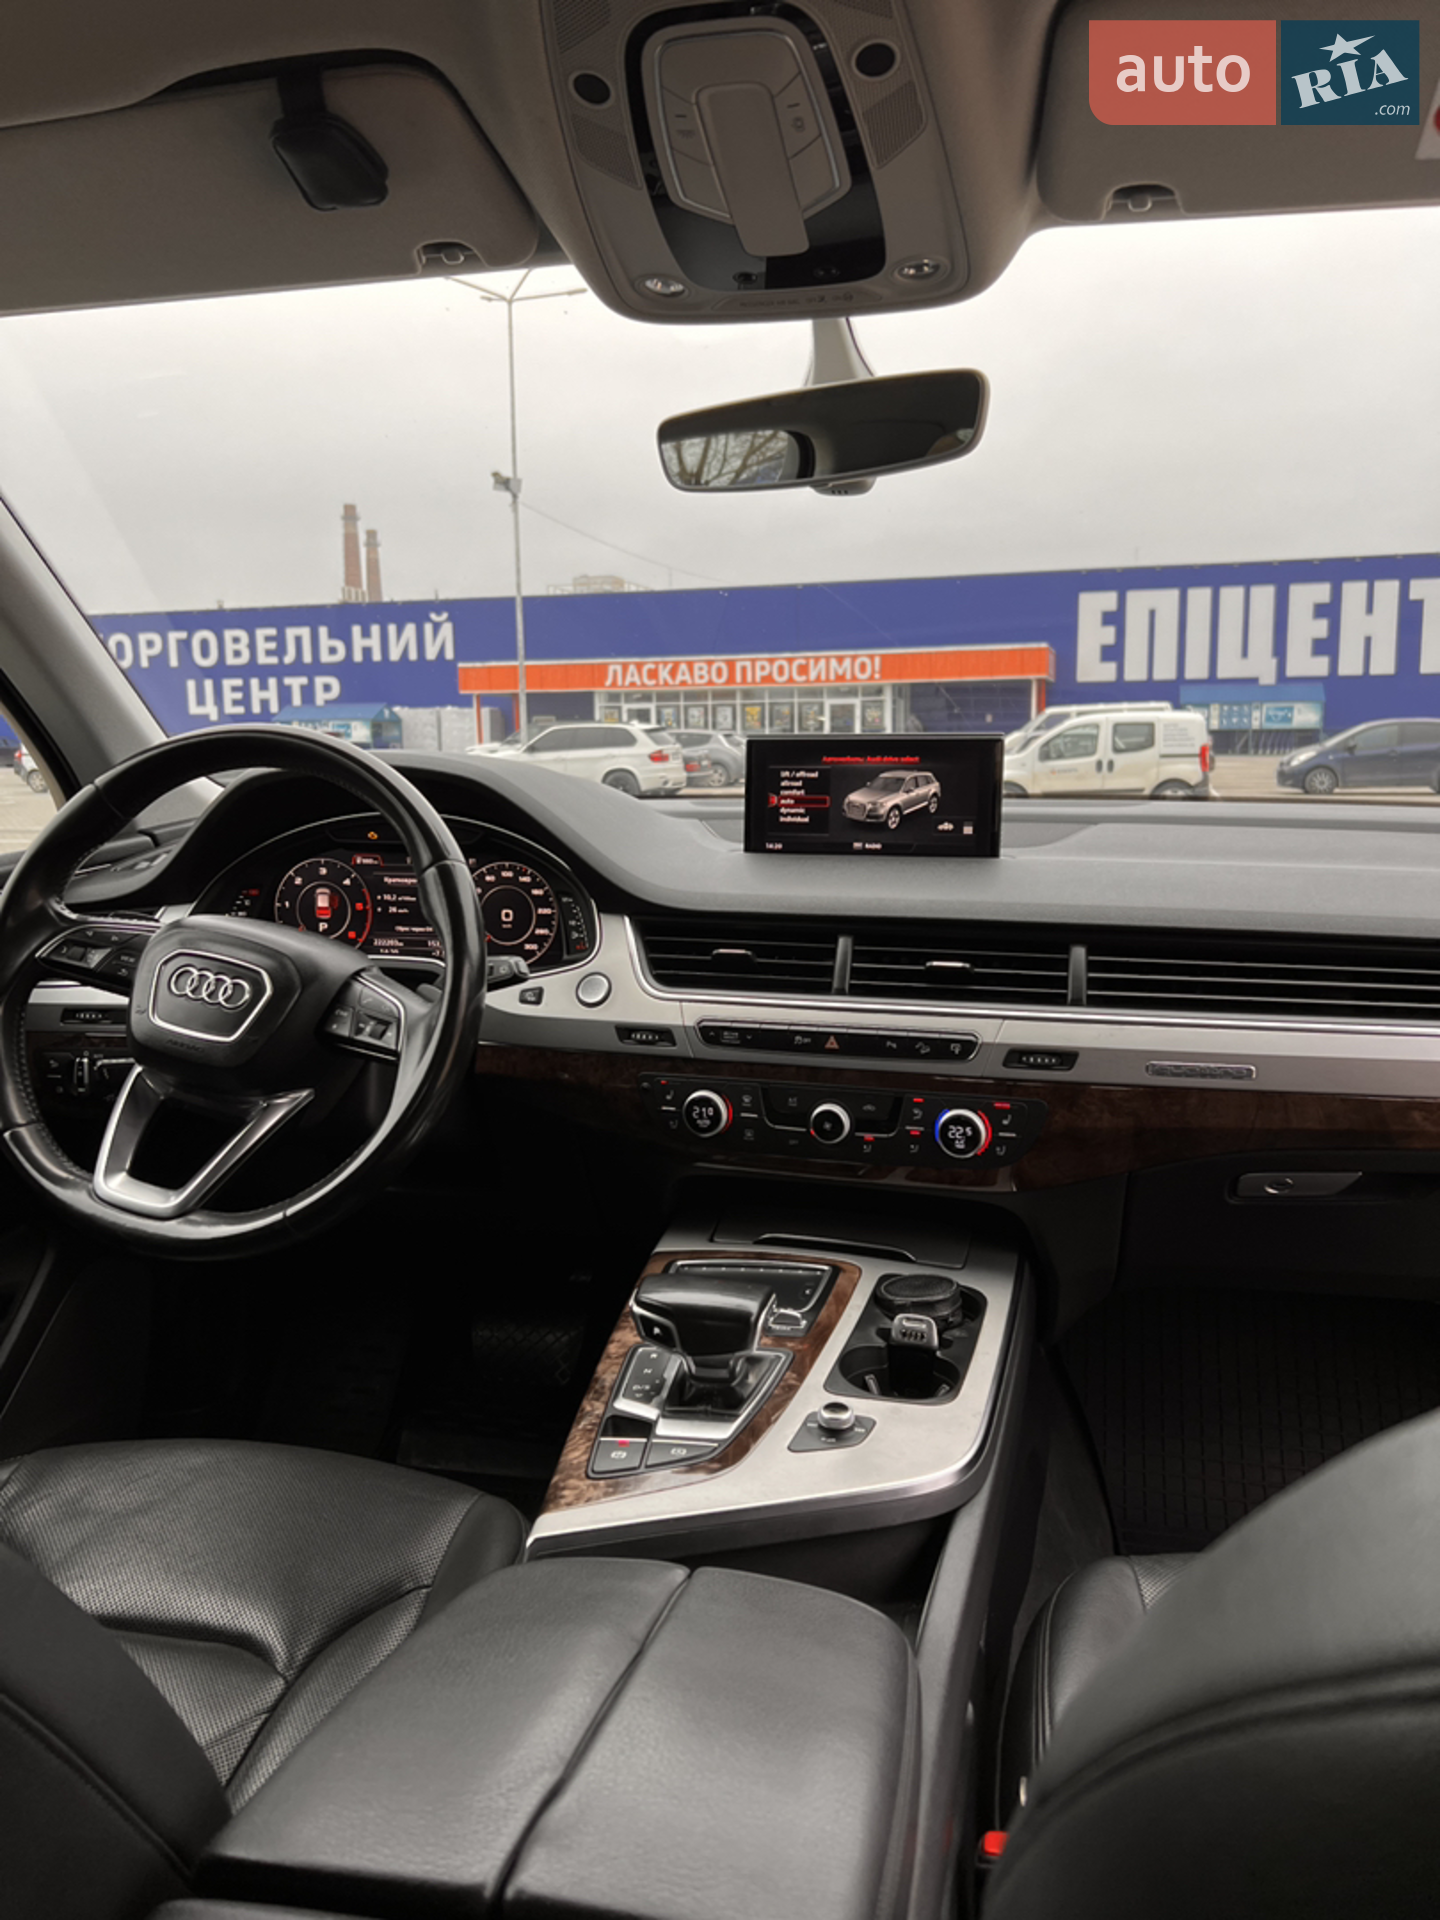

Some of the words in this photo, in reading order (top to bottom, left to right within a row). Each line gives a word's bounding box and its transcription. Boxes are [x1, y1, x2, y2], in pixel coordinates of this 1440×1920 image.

[100, 611, 456, 670] ОРГОВЕЛЬНИЙ
[1076, 577, 1440, 686] ЕПІЦЕНТ
[605, 661, 729, 688] ЛАСКАВО
[735, 655, 882, 684] ПРОСИМО!
[185, 675, 342, 722] ЦЕНТР
